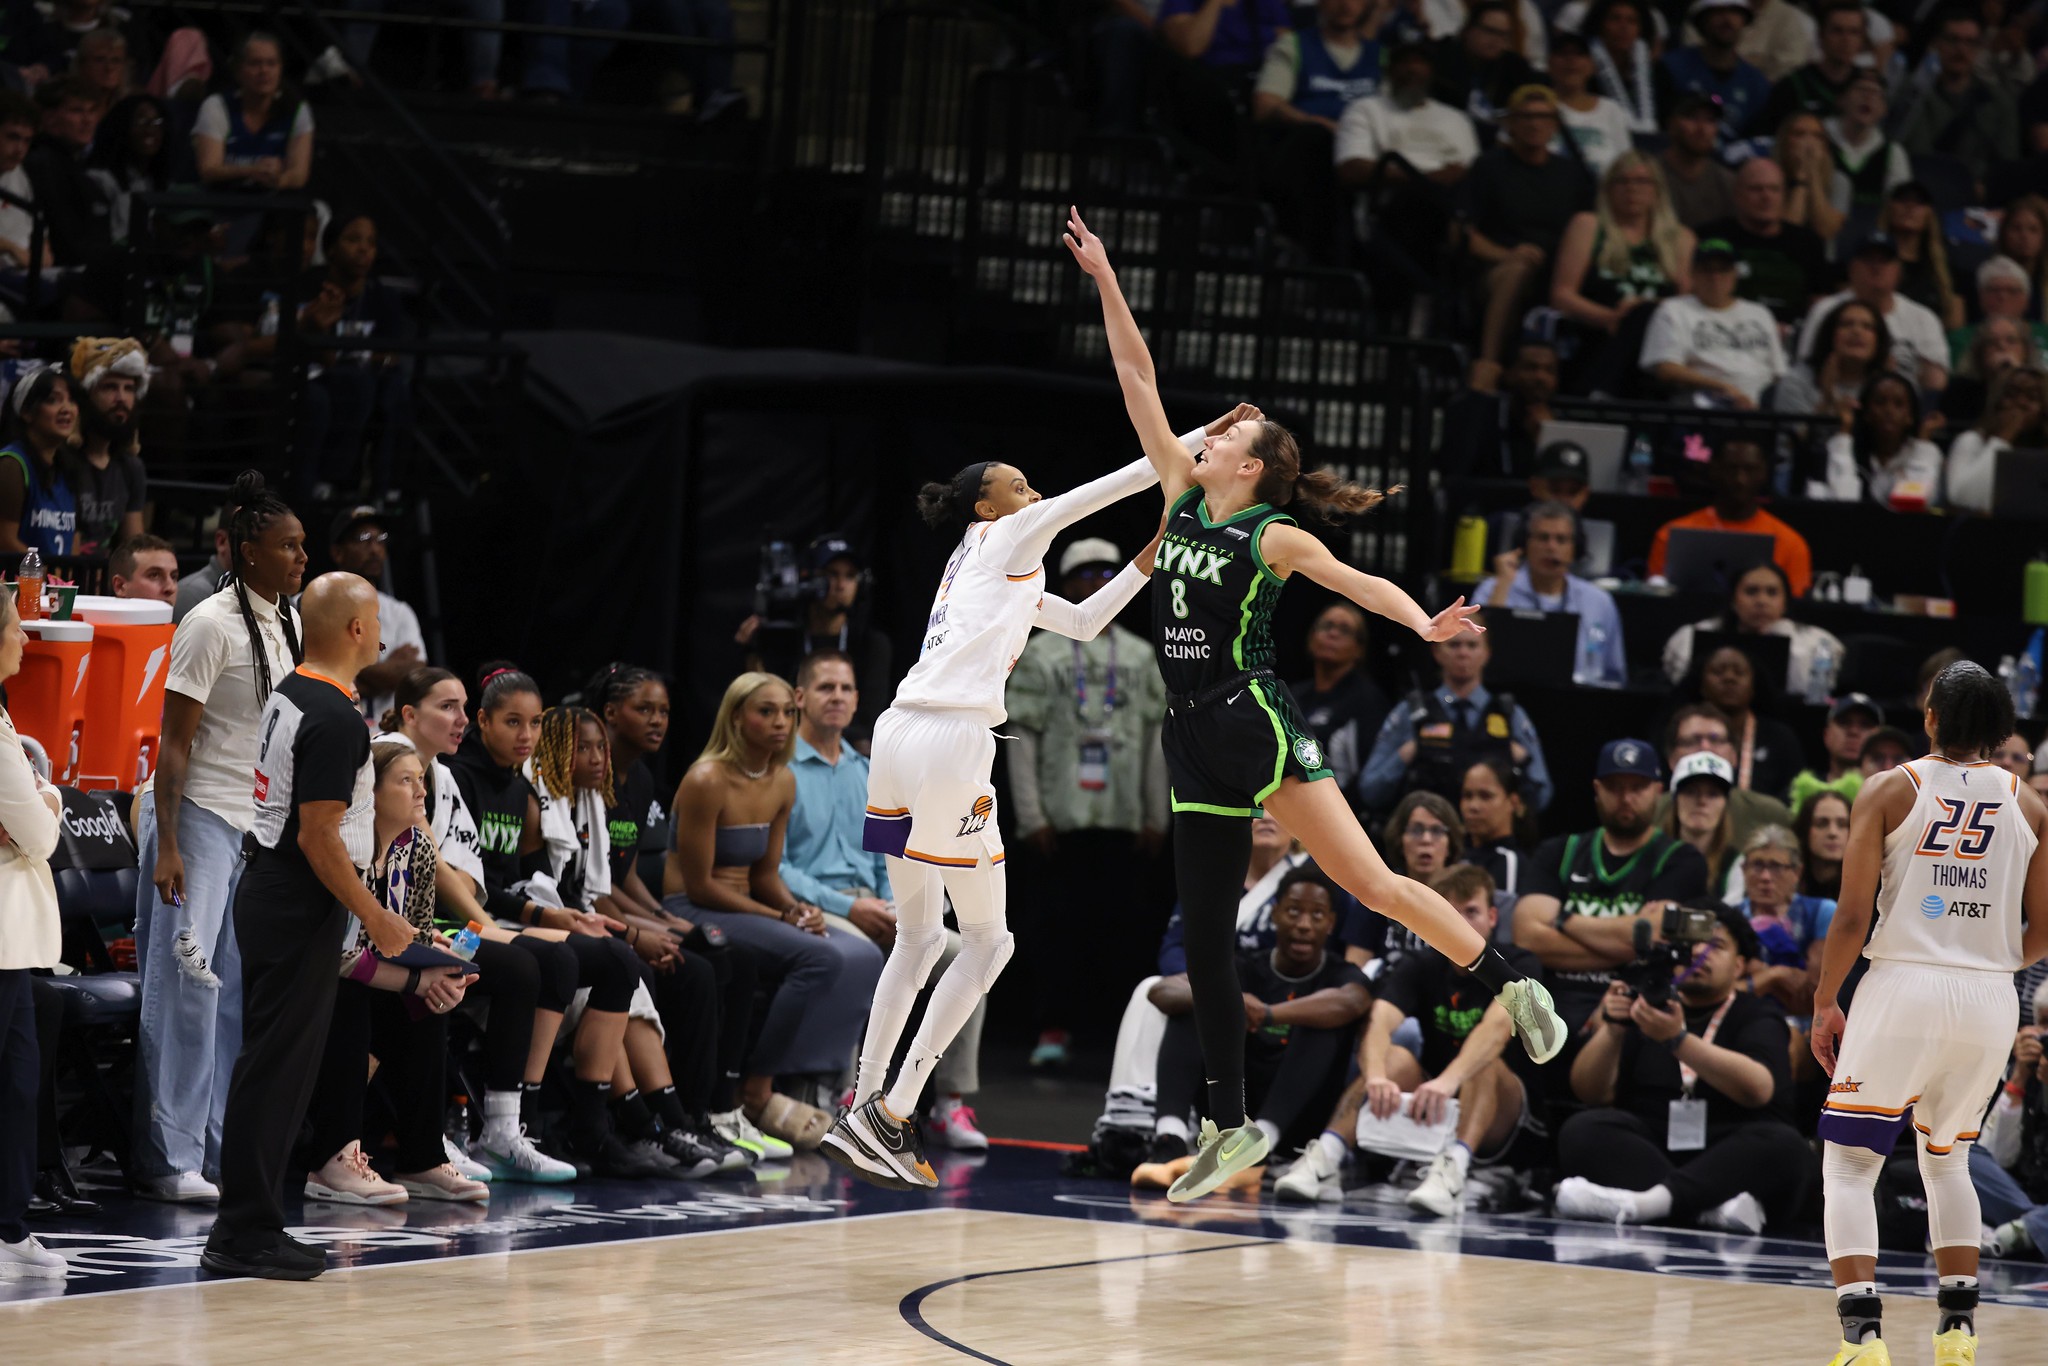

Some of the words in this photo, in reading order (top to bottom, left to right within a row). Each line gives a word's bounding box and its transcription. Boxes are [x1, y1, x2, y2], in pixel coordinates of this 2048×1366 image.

[1154, 539, 1232, 586] LYNX
[1169, 578, 1190, 620] 8
[927, 629, 950, 650] AT&T
[1164, 626, 1206, 643] MAYO
[1164, 644, 1211, 660] CLINIC
[259, 708, 280, 763] 9
[1914, 795, 2003, 860] 25
[1932, 864, 1987, 889] THOMAS
[1947, 901, 1991, 919] AT&T
